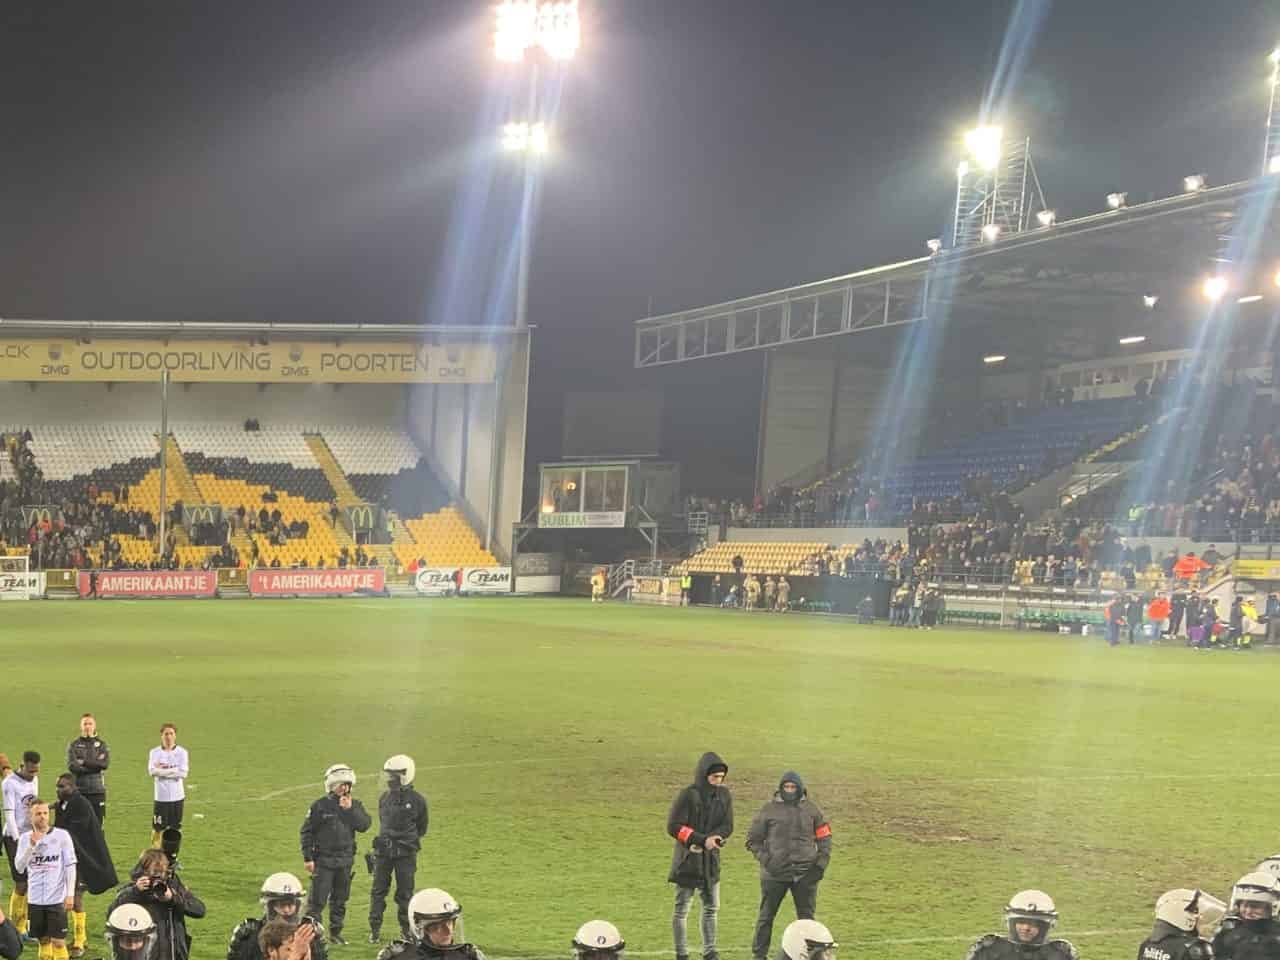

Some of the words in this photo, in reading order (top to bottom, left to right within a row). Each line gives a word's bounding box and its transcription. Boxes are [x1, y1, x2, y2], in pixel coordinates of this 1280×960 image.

[81, 351, 271, 371] OUTDOORLIVING
[320, 353, 430, 371] POORTEN
[40, 364, 70, 376] DMG
[281, 366, 310, 377] DMG
[101, 576, 208, 592] AMERIKAANTJE
[271, 574, 376, 589] AMERIKAANTJE
